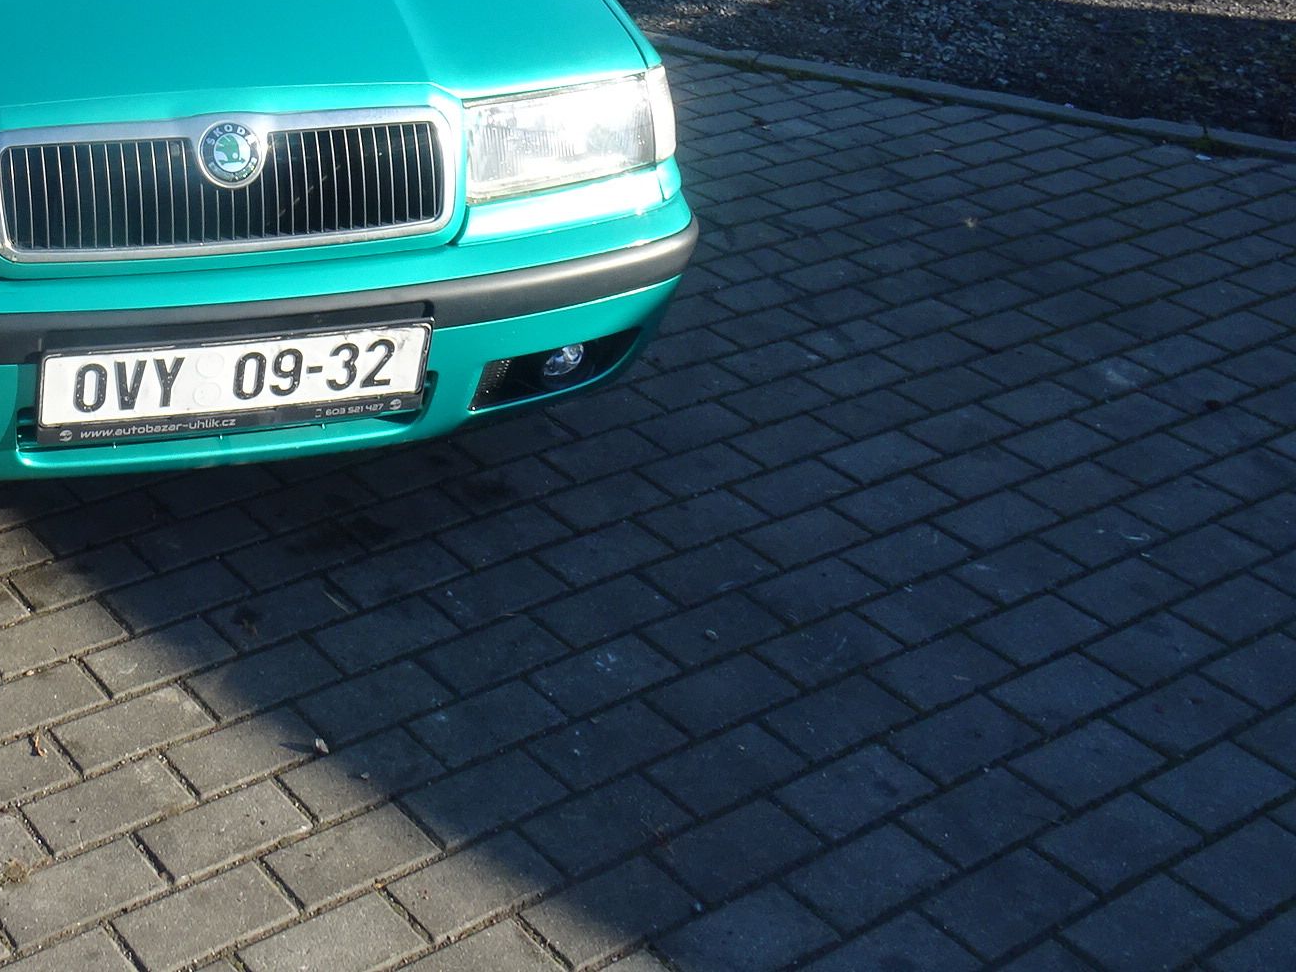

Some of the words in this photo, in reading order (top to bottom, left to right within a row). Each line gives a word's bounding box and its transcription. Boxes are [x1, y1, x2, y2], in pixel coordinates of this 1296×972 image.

[72, 356, 186, 414] OVY
[232, 338, 397, 402] 09-32
[80, 418, 236, 439] www.autobazar-uhlik.cz
